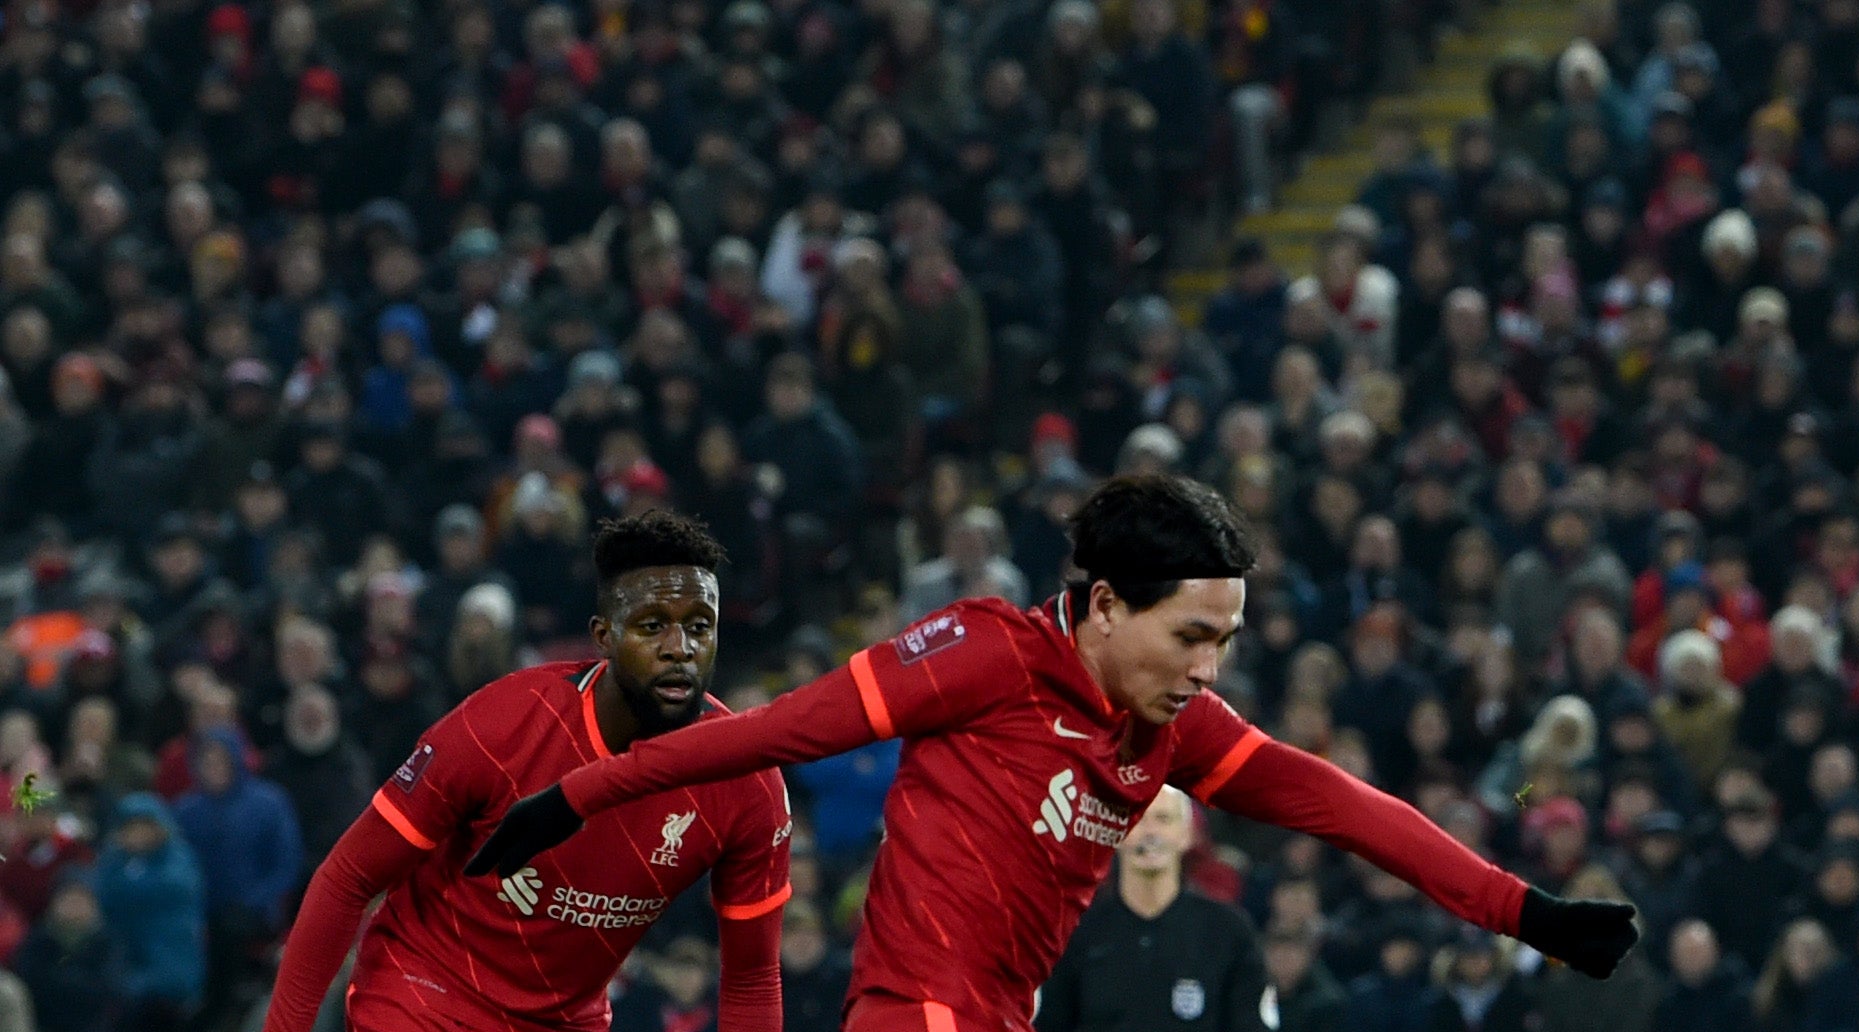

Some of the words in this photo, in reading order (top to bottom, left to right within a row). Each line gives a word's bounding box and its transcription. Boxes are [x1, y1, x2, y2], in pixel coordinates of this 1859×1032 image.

[650, 852, 680, 867] LFC
[552, 886, 668, 912] standard
[547, 904, 660, 929] chartered
